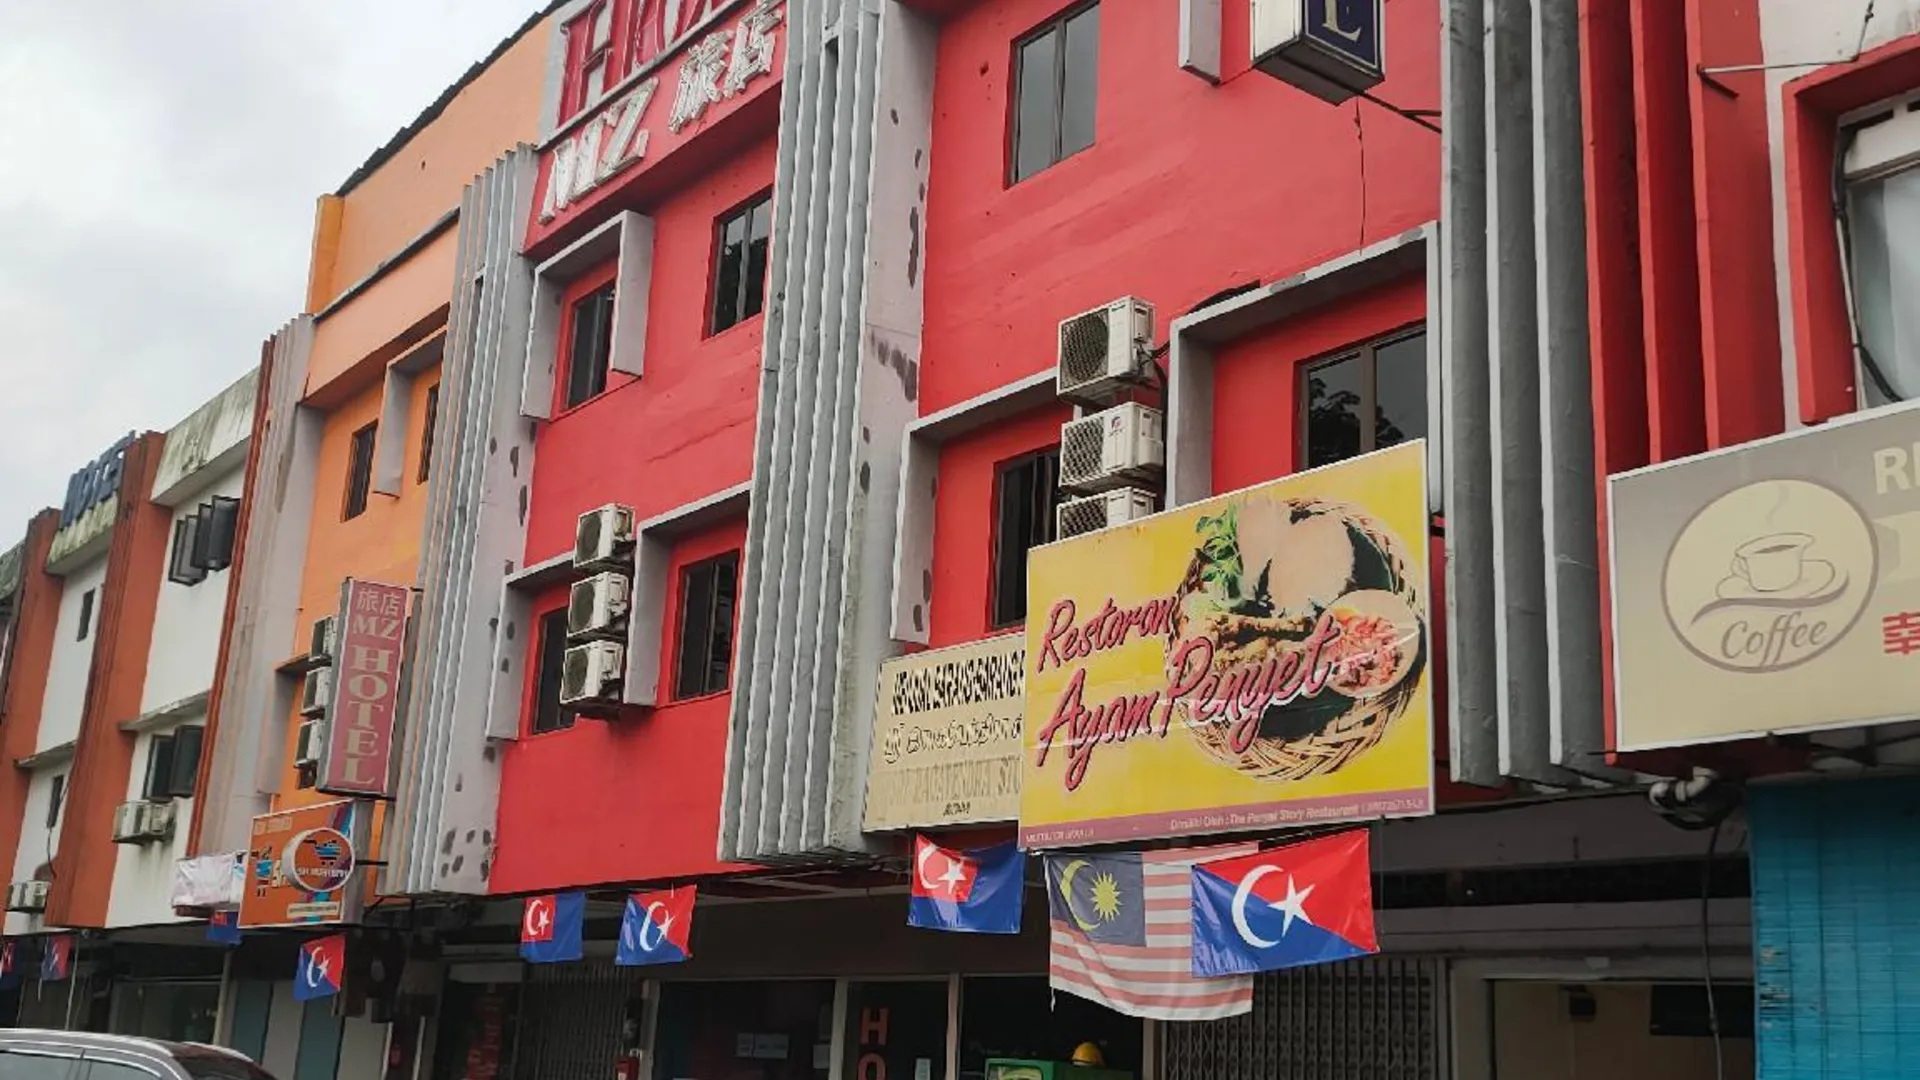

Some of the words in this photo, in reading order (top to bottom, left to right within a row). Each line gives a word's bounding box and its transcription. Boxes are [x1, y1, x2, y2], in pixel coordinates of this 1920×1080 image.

[537, 77, 660, 225] MZ
[352, 614, 400, 641] MZ
[356, 587, 401, 616] 旅店
[1036, 596, 1178, 673] Restoran
[1720, 610, 1828, 668] Coffee
[343, 644, 395, 786] HOTEL
[1036, 668, 1160, 792] Ayam
[1159, 613, 1340, 755] Penyet
